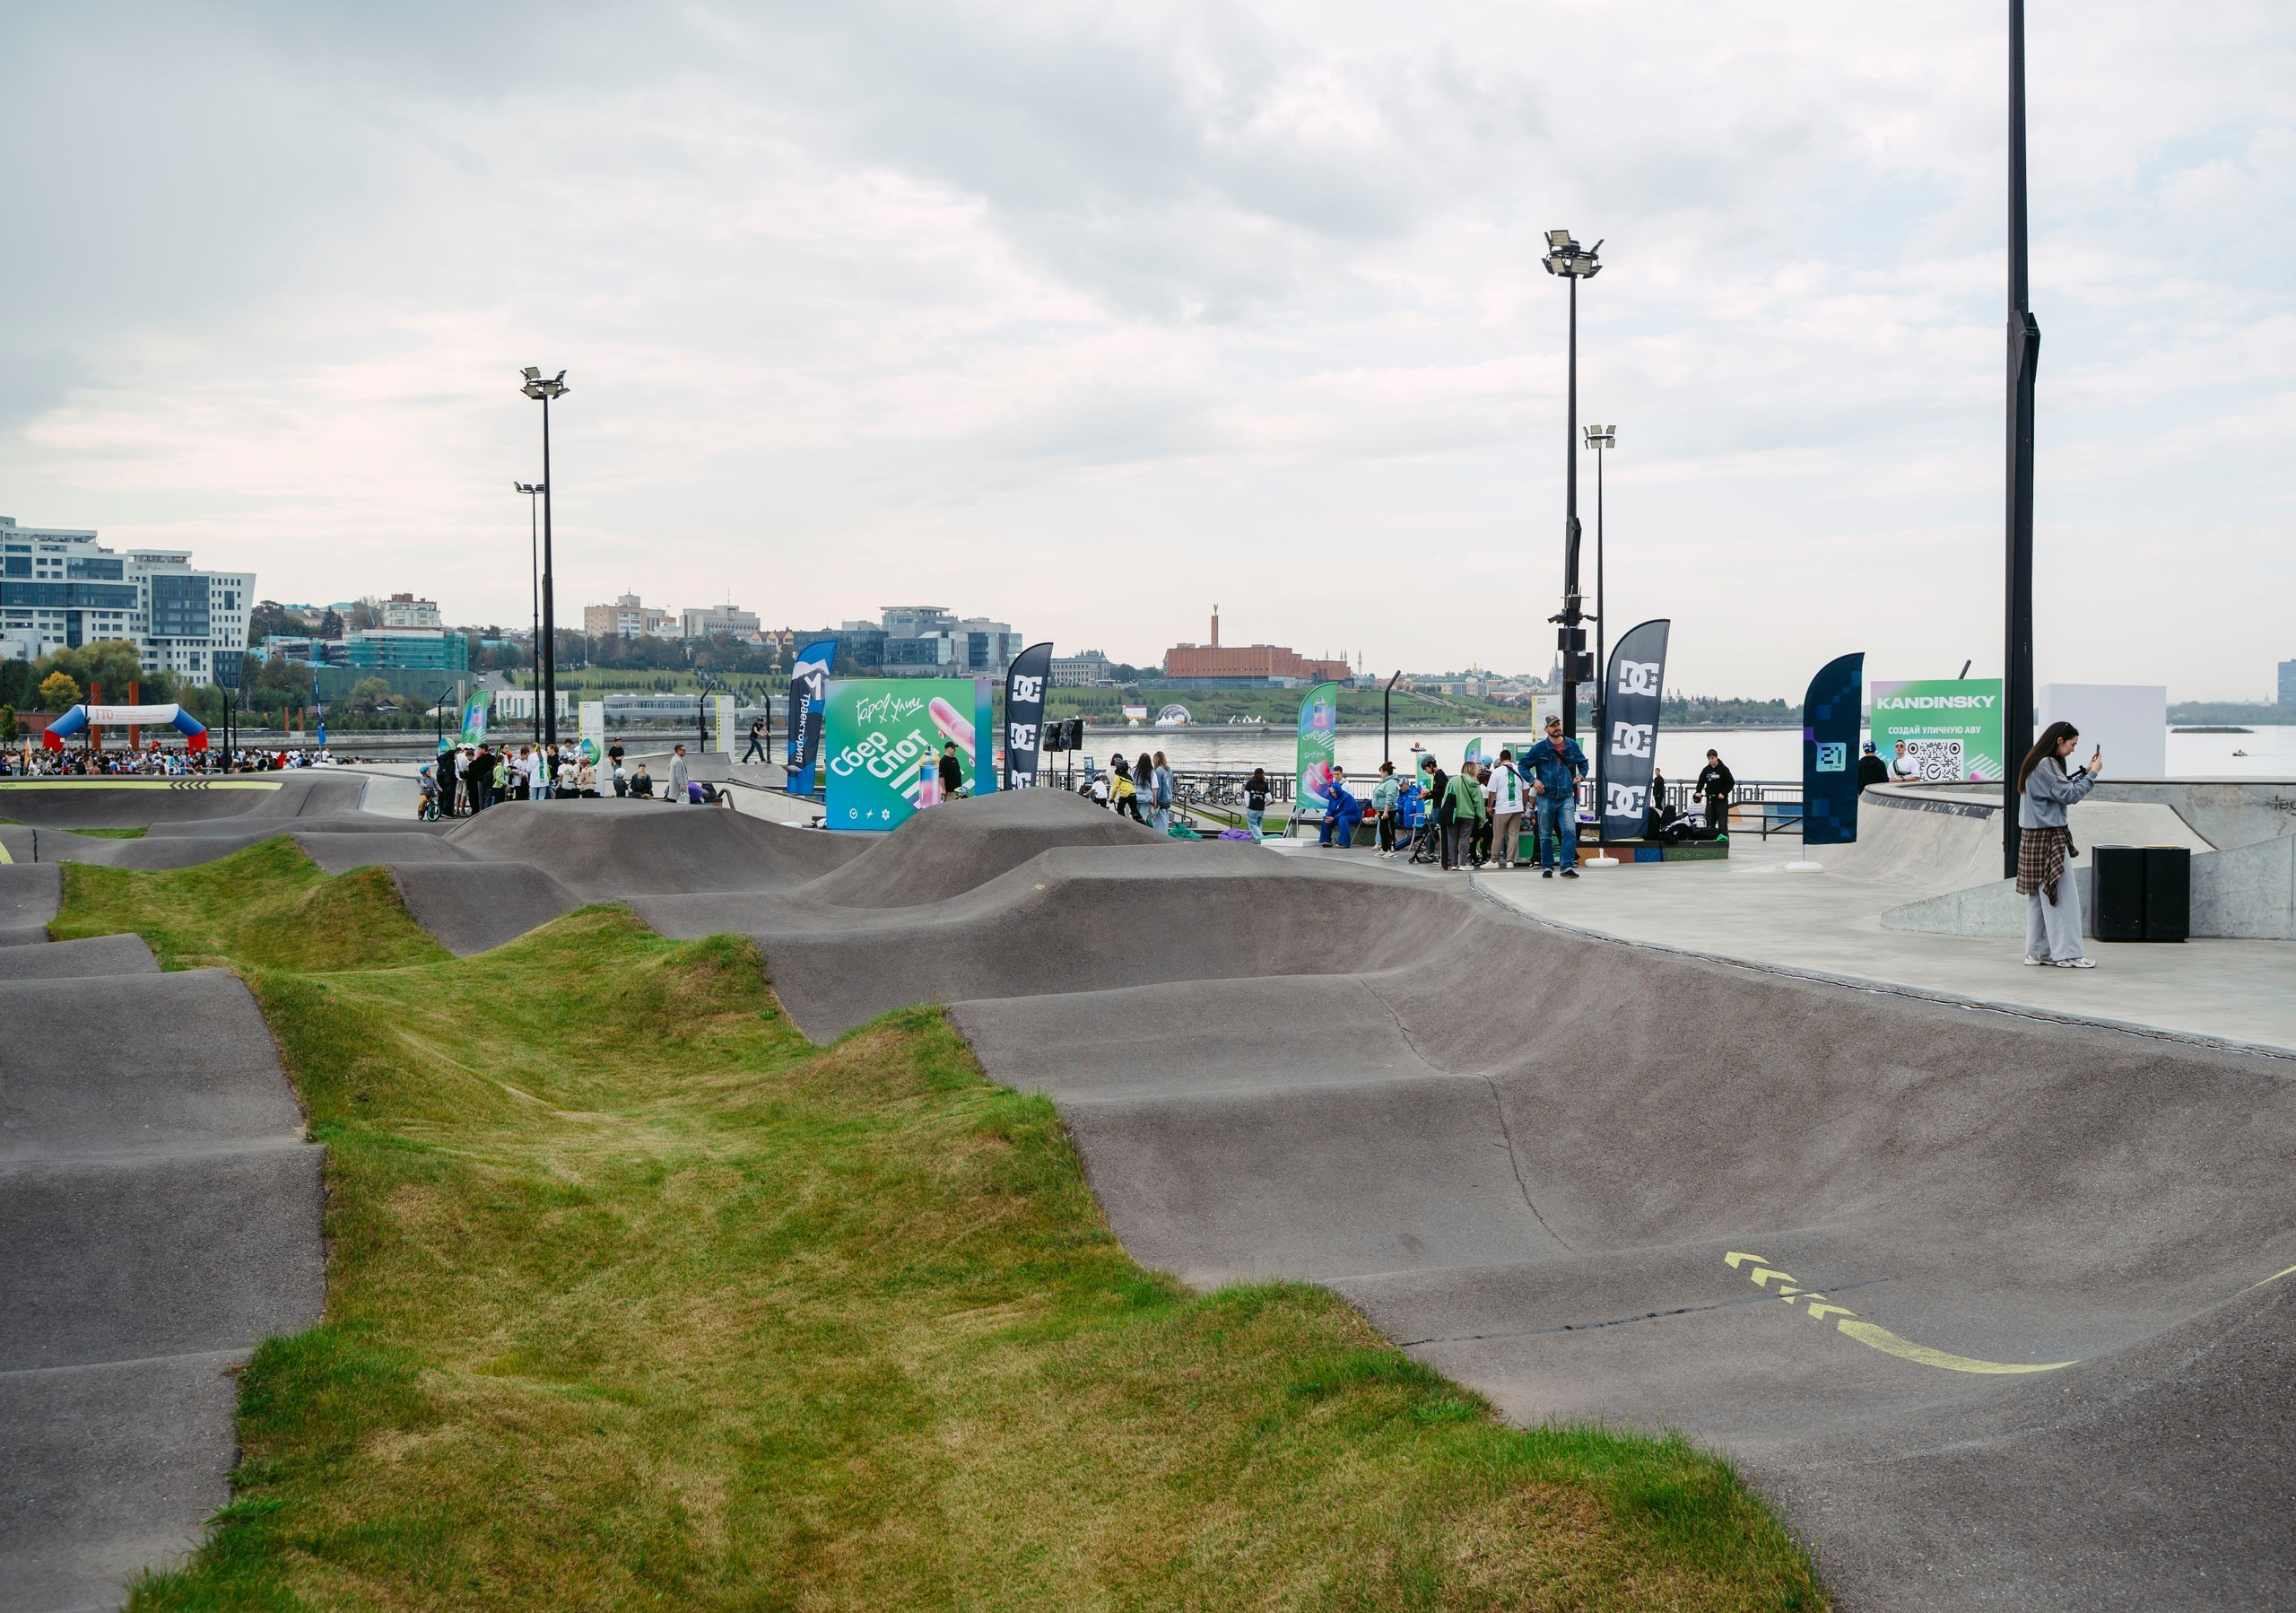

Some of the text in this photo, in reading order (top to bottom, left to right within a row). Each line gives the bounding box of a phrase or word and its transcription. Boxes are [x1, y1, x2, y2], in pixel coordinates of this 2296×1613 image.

[856, 693, 891, 727] Город
[1877, 695, 1996, 709] KANDINSKY
[1888, 724, 1981, 735] СОЗДАЙ УЛИЧНУЮ АВУ
[830, 731, 889, 777] Сбер
[866, 728, 929, 779] Спот
